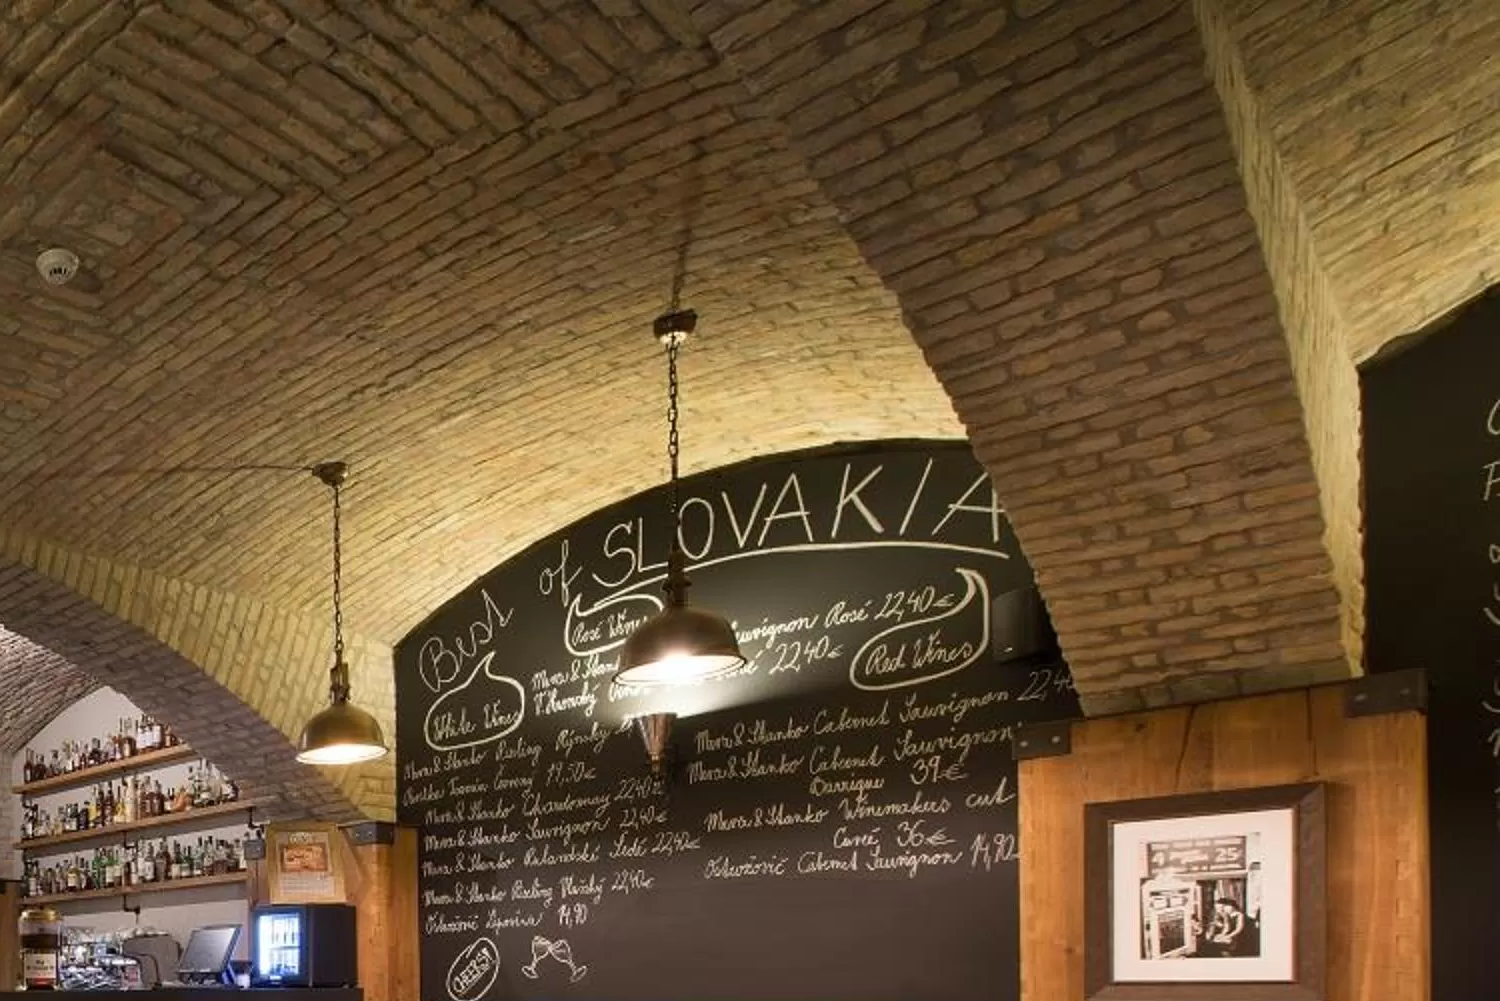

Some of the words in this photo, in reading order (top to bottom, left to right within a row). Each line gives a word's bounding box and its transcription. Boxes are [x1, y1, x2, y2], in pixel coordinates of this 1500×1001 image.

[419, 588, 514, 693] Best
[538, 538, 583, 608] of
[592, 457, 1006, 587] SLOVAKIA
[825, 599, 873, 629] Rosé
[865, 644, 906, 677] Red
[912, 628, 975, 671] Wines
[898, 687, 1011, 725] Sauvignon
[964, 776, 1017, 806] cut
